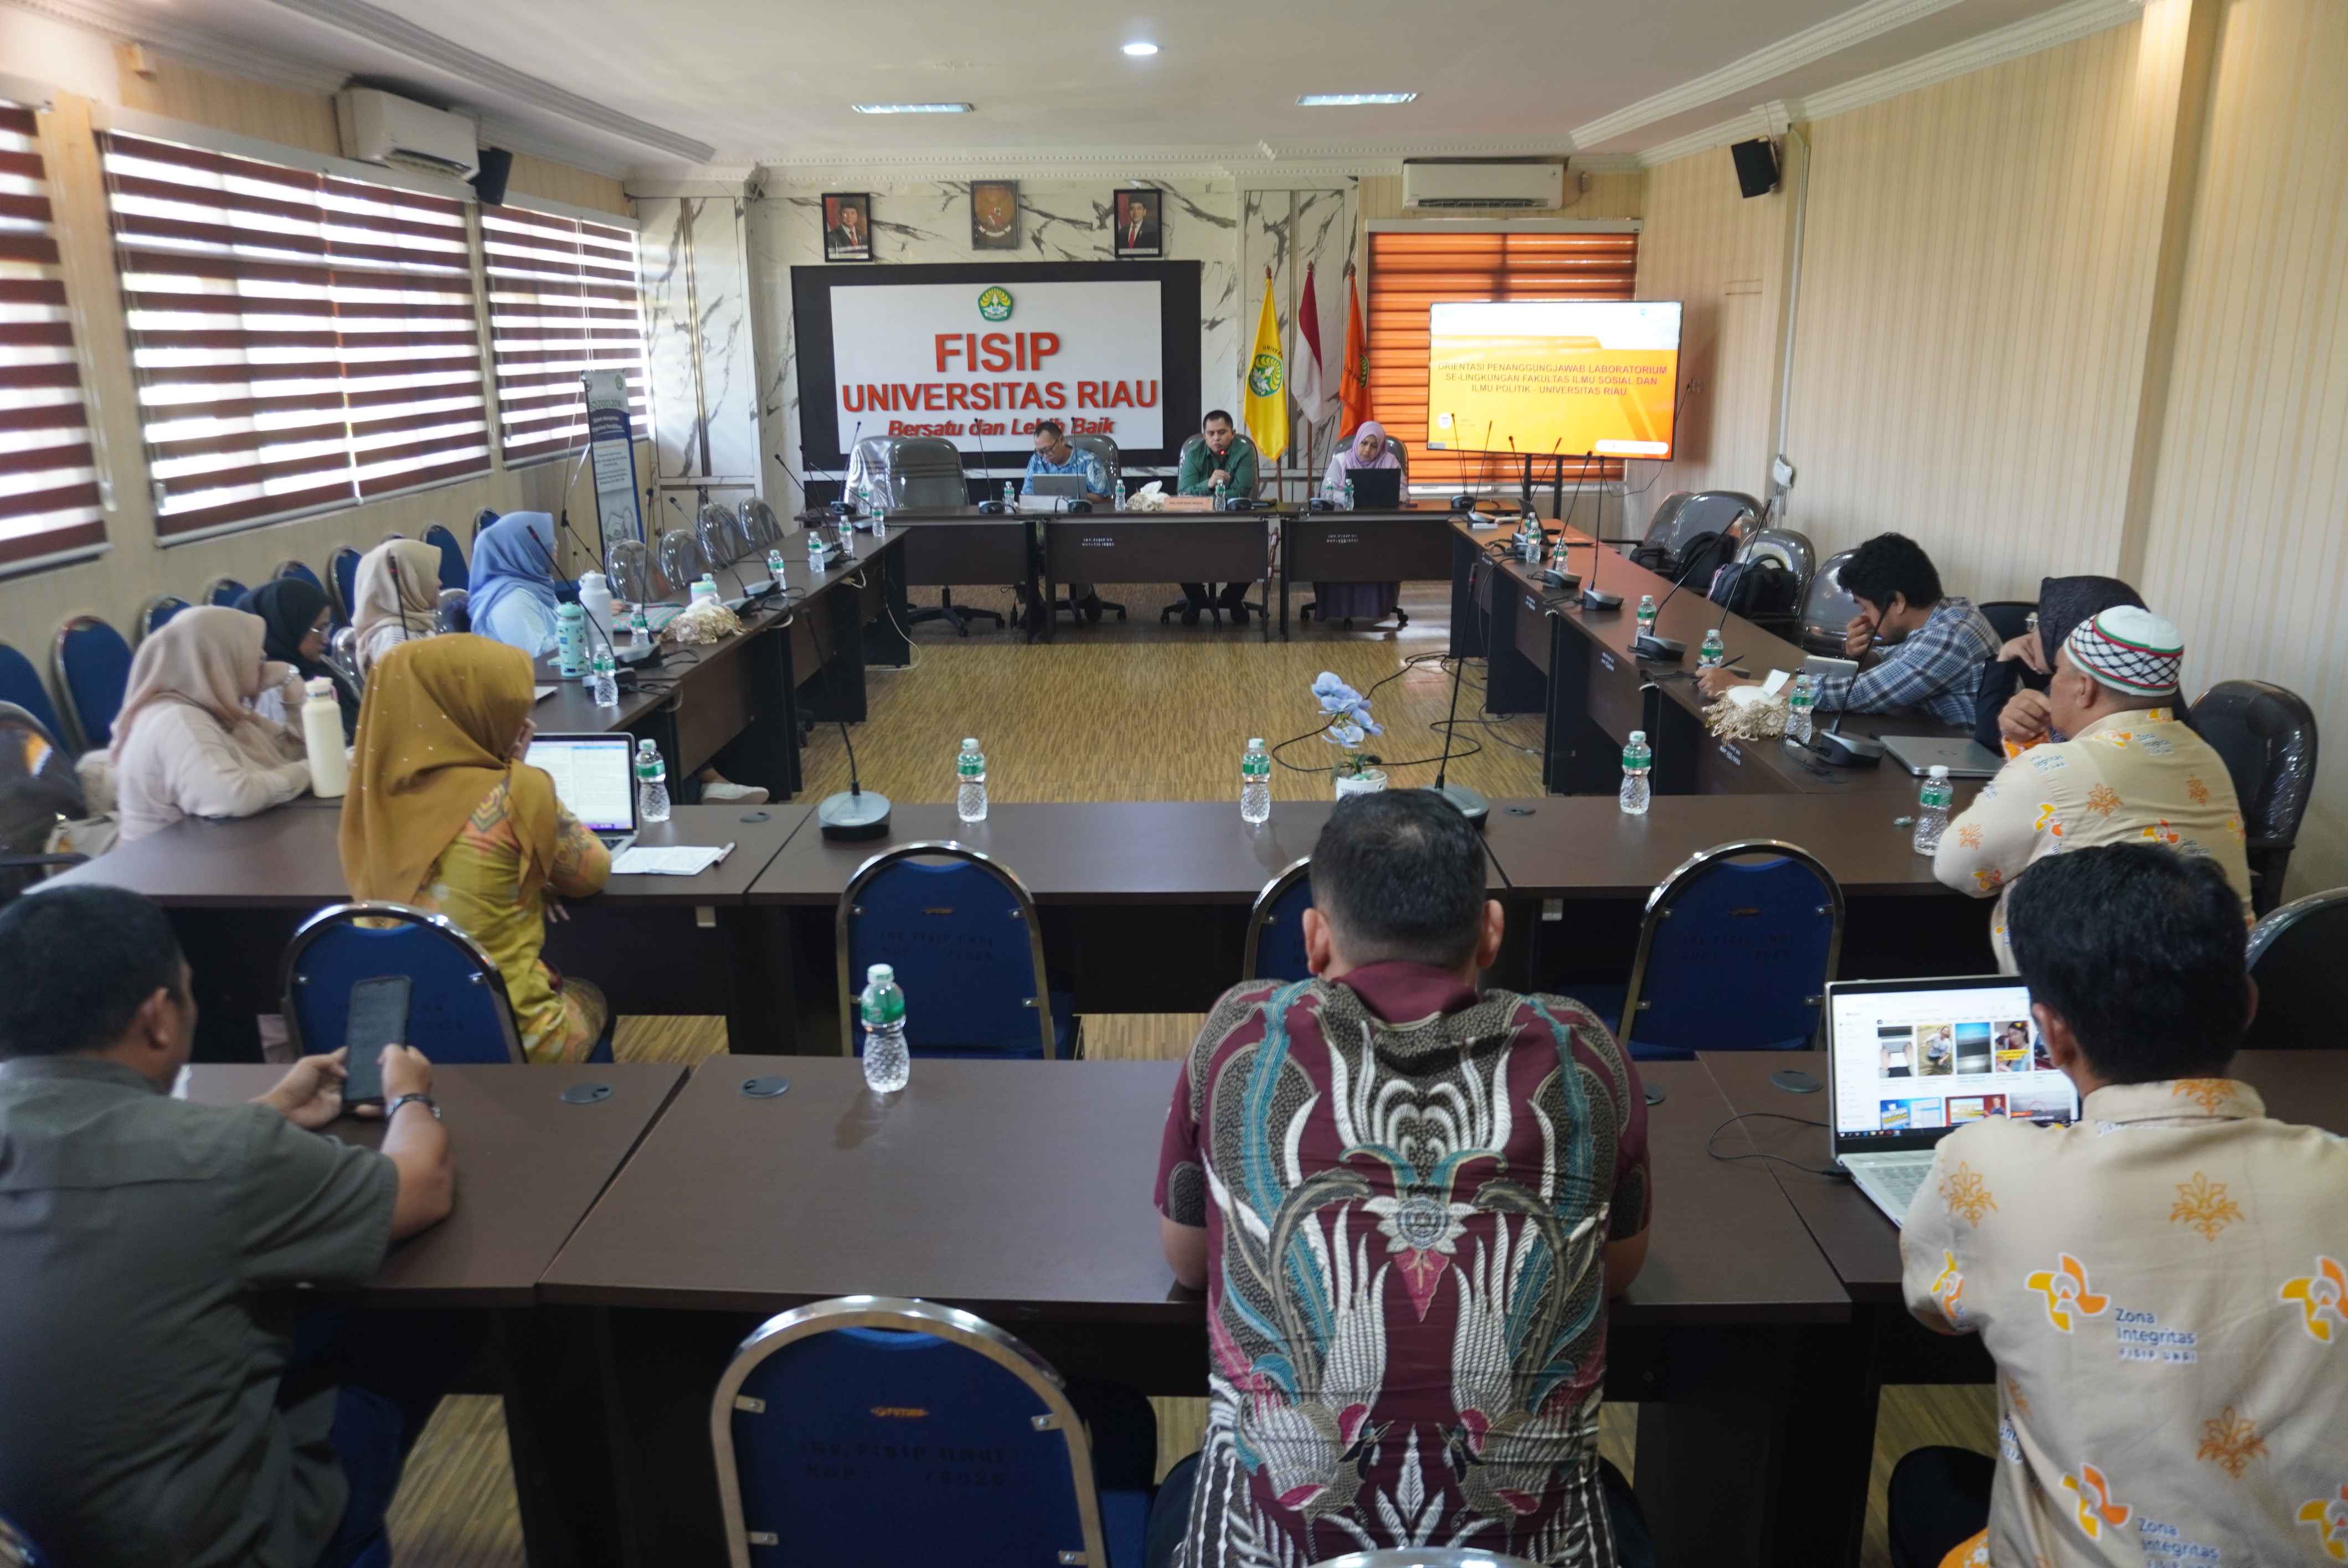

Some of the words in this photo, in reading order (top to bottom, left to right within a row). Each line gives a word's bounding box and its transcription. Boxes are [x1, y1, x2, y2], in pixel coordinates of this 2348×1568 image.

[936, 332, 1059, 373] FISIP
[1487, 363, 1585, 373] PENANGGUNGJAWAB
[1589, 365, 1667, 374] LABORATORIUM
[1446, 373, 1520, 381] SE-LINGKUNGAN
[1523, 374, 1569, 383] FAKULTAS
[1599, 376, 1632, 385] SOSIAL
[843, 381, 1065, 412] UNIVERSITAS
[1077, 380, 1156, 408] RIAU
[1539, 386, 1600, 395] UNIVERSITAS
[1604, 387, 1626, 395] RIAU
[888, 420, 963, 436] Bersatu
[969, 419, 1005, 435] dan
[1071, 417, 1113, 434] Baik
[2115, 1308, 2155, 1324] Zona
[2117, 1327, 2196, 1345] Integritas
[2139, 1517, 2177, 1536] Zona
